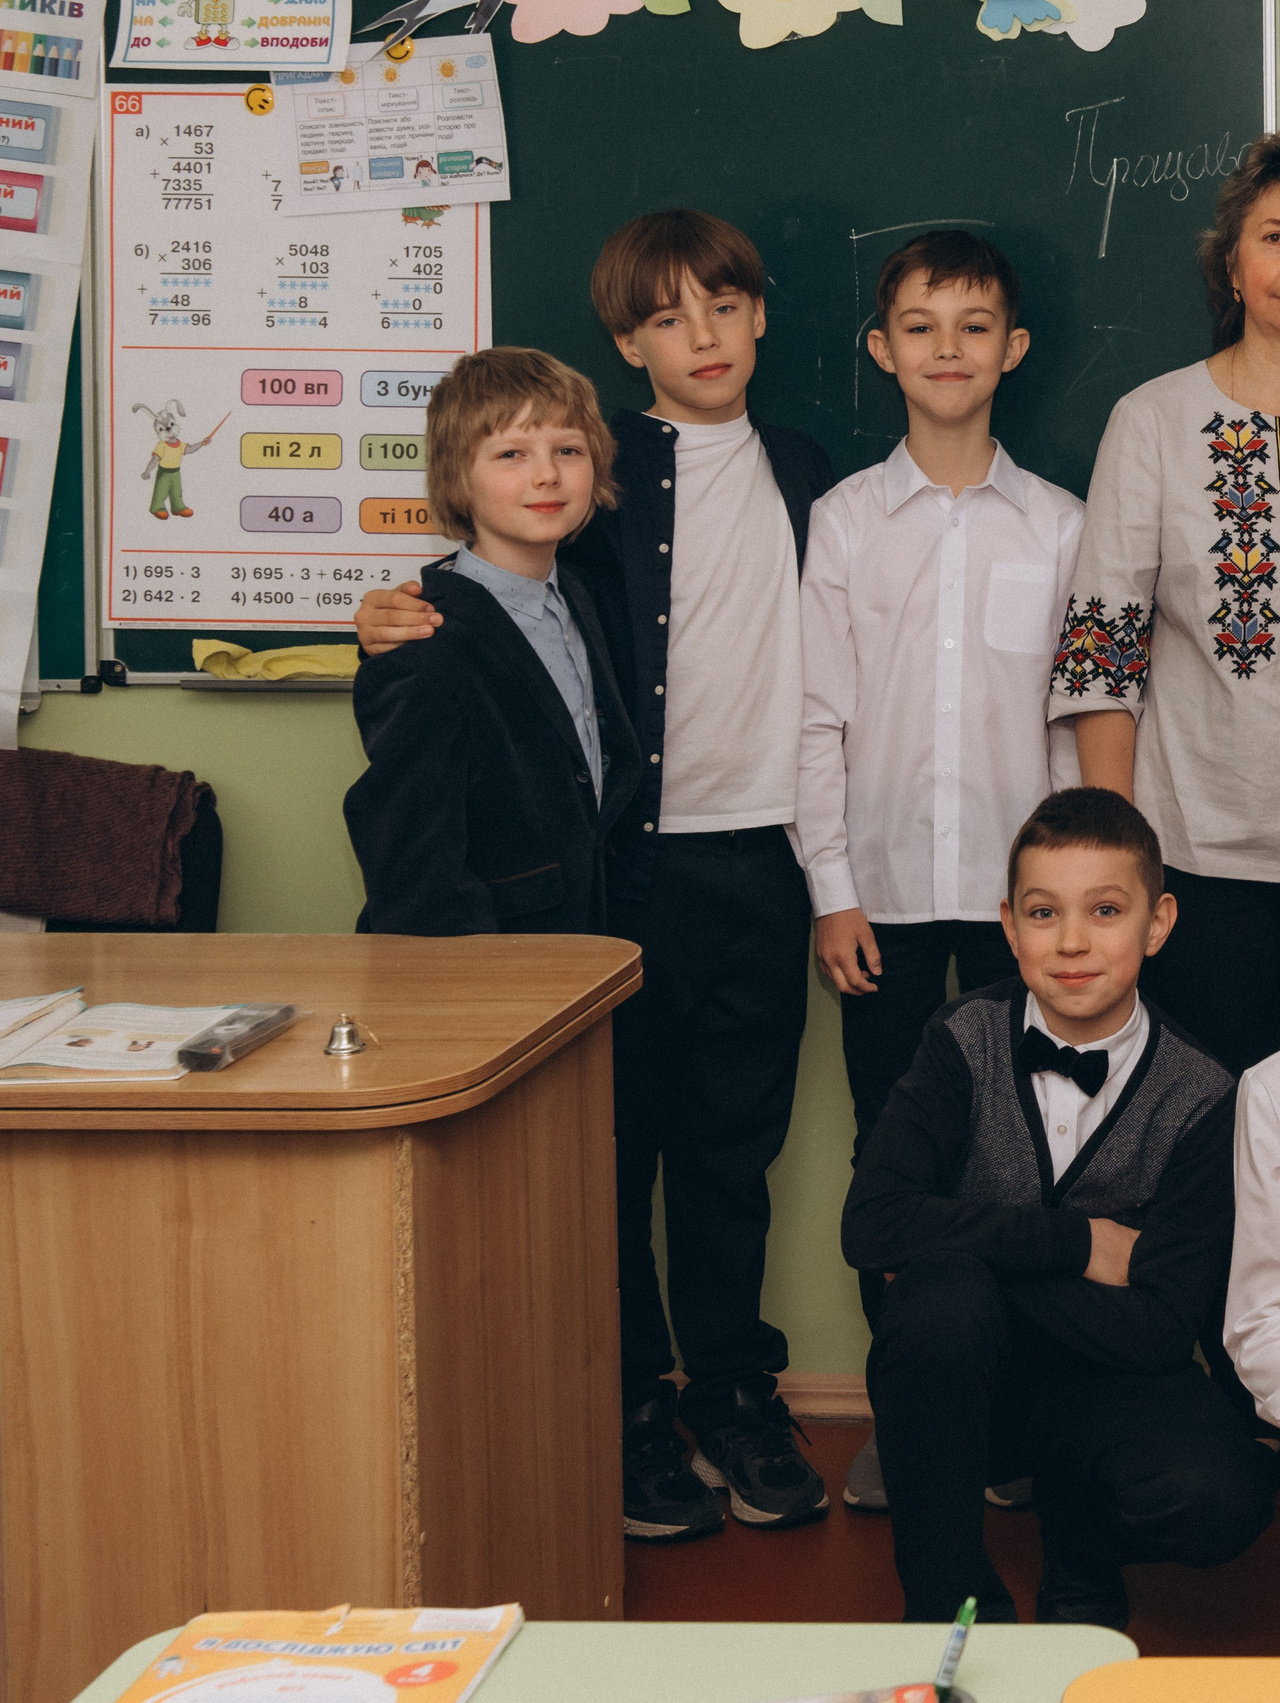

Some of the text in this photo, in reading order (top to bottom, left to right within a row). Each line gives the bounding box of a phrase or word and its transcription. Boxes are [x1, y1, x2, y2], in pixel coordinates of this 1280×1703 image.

[133, 15, 330, 29] НА ДОБРАНІЧ
[131, 37, 329, 49] ДО ВПОДОБИ
[115, 95, 140, 112] 66
[135, 125, 214, 140] а) 1467
[194, 142, 214, 155] 53
[172, 162, 212, 174] 4401
[161, 179, 202, 191] 7335
[271, 180, 281, 192] 7
[162, 198, 212, 210] 77751
[272, 199, 282, 211] 7
[134, 241, 443, 259] б) 2416 5048 1705
[181, 258, 443, 276] 306 103 402
[258, 378, 328, 395] 100 вп
[263, 442, 321, 458] пі 2 л
[380, 443, 418, 459] 100
[268, 506, 314, 523] 40 а
[380, 508, 432, 524] ті 10
[122, 565, 201, 580] 1) 695 3
[230, 567, 247, 582] 3)
[253, 567, 283, 580] 695
[300, 568, 311, 580] 3
[333, 568, 364, 581] 642
[381, 569, 391, 581] 2
[121, 589, 201, 604] 2) 642 2
[231, 591, 247, 606] 4)
[253, 591, 294, 604] 4500
[316, 592, 353, 607] (695
[402, 1636, 466, 1655] СВІТ
